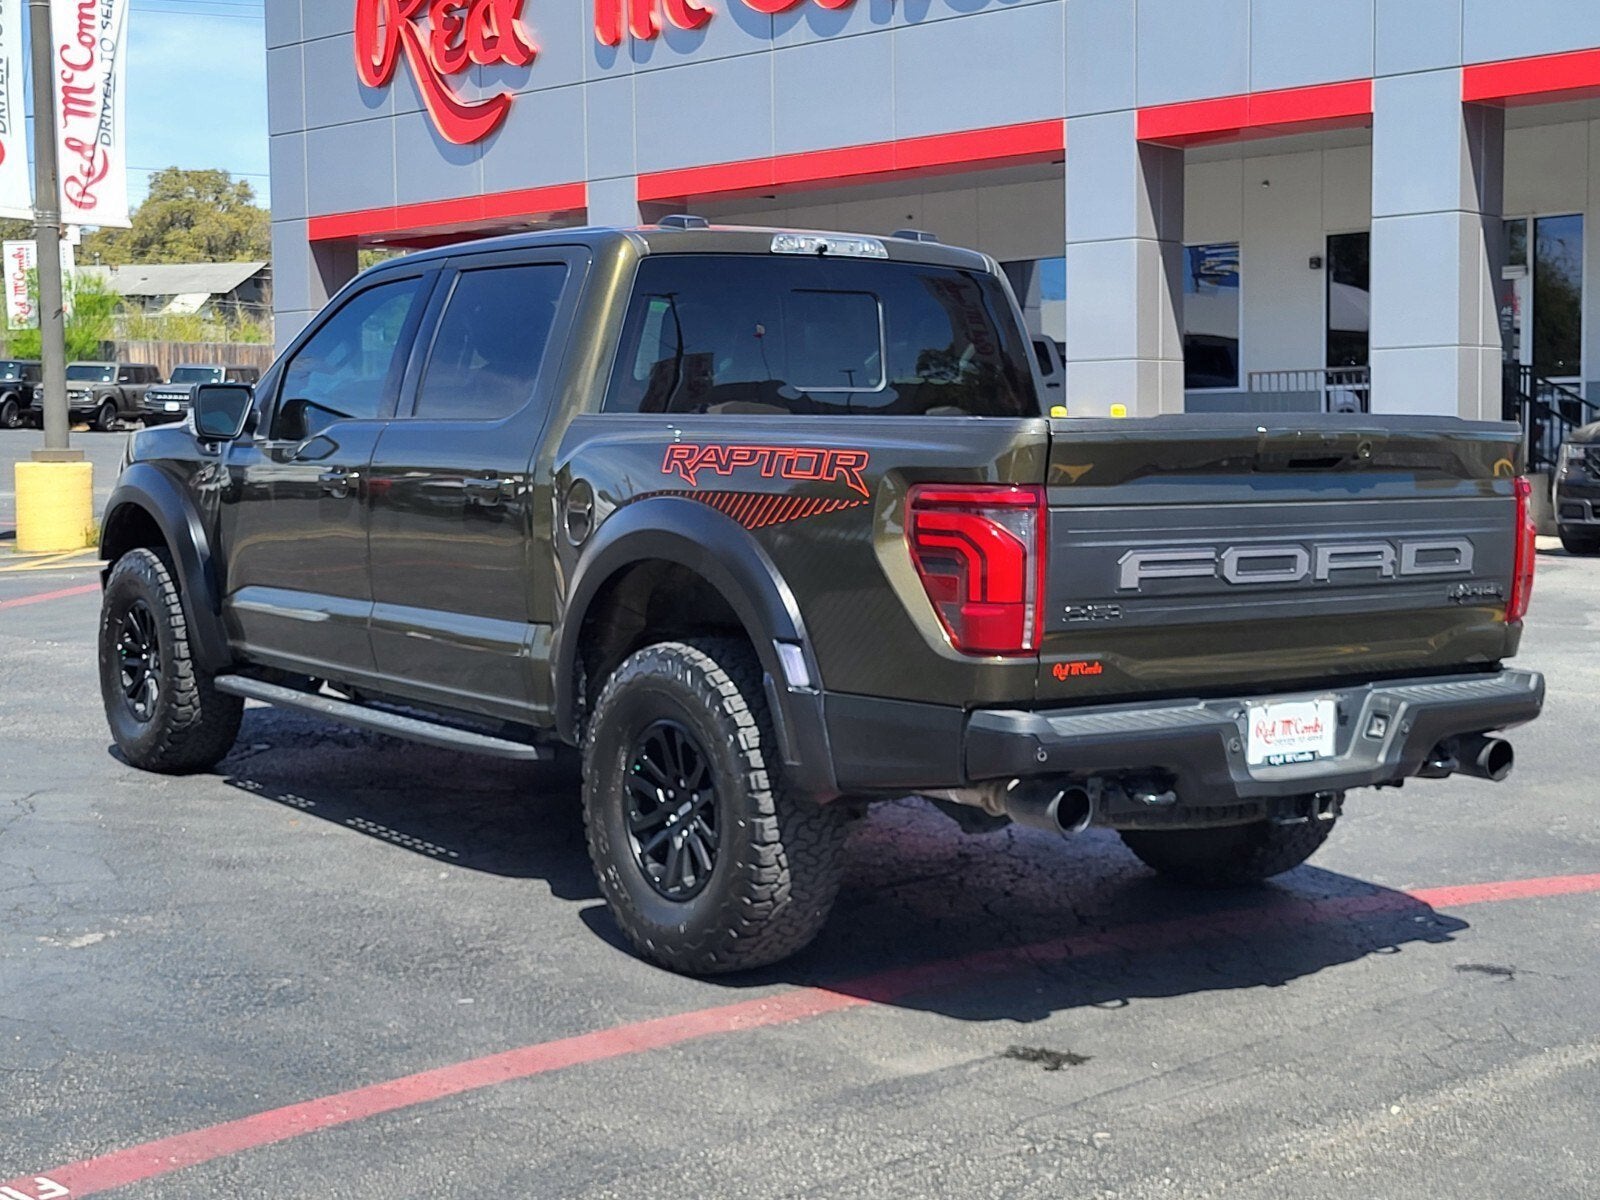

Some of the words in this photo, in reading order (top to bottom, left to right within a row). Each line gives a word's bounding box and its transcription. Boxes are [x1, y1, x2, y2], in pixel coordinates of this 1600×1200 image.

[60, 0, 96, 129] McCom
[100, 38, 114, 63] TO
[100, 72, 113, 147] DRIVEN
[64, 137, 109, 209] Red
[661, 444, 870, 498] RAPTOR
[1116, 537, 1475, 593] FORD
